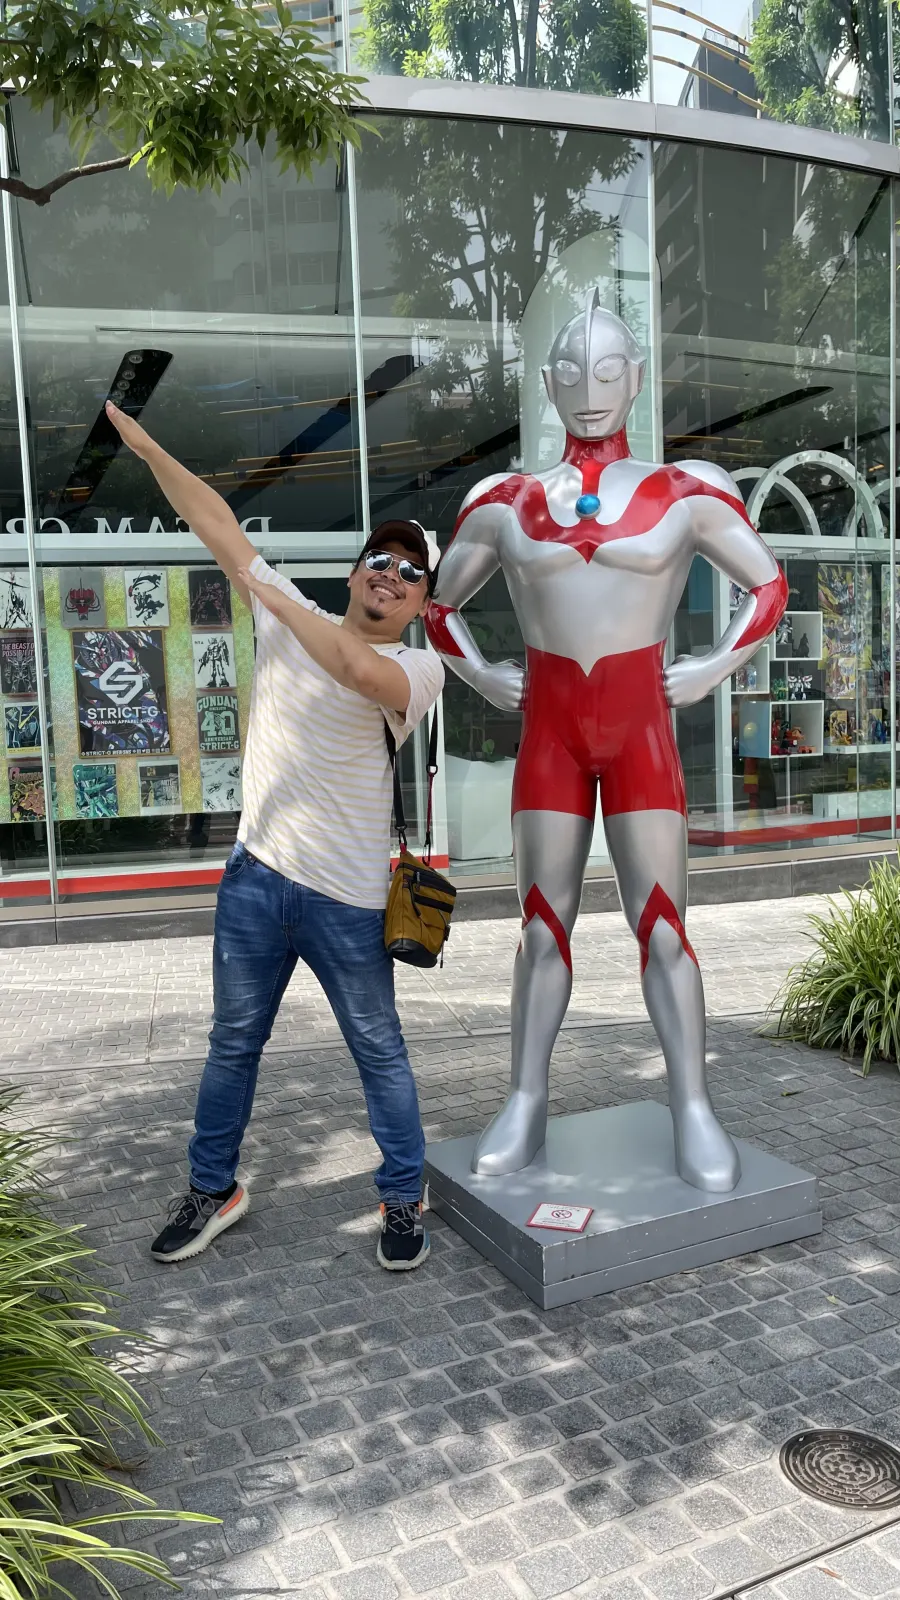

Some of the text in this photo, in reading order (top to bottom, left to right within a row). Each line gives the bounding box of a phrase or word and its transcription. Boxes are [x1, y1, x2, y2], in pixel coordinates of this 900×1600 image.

[197, 696, 238, 712] GUNDAM
[87, 706, 158, 719] STRICT-G
[200, 740, 239, 751] STRICT-G
